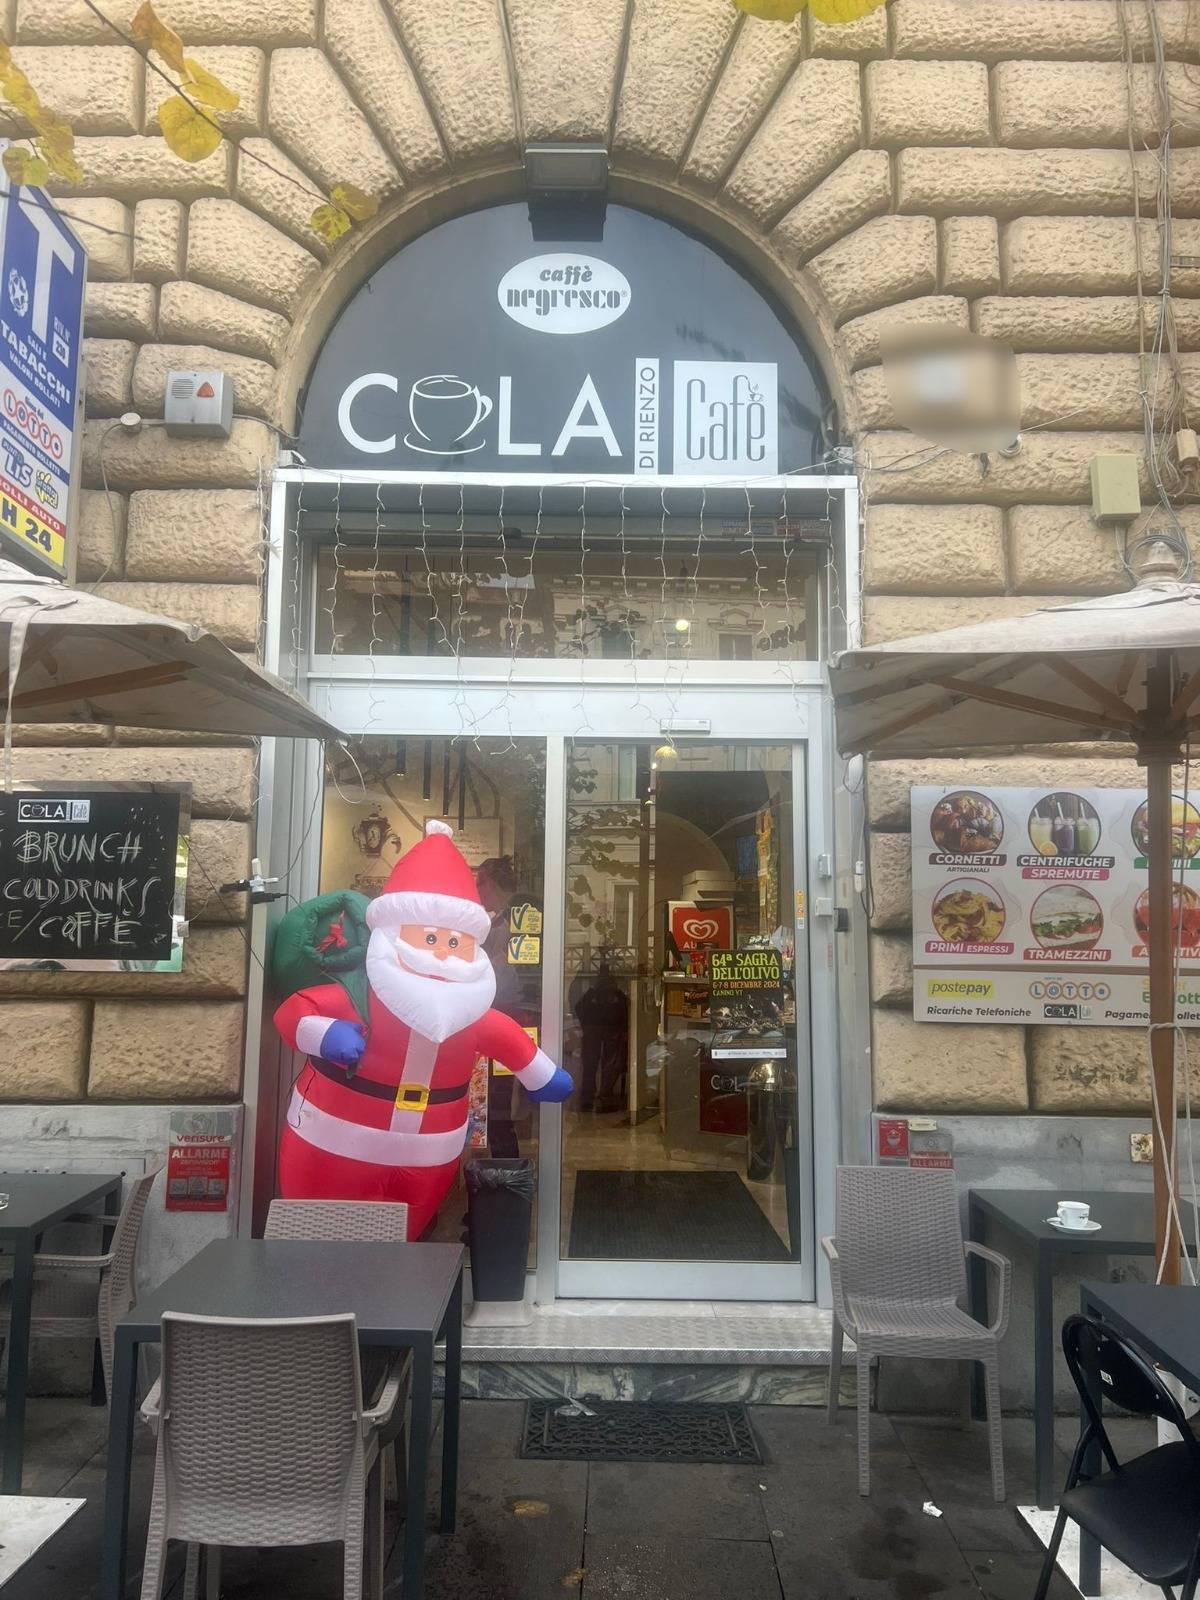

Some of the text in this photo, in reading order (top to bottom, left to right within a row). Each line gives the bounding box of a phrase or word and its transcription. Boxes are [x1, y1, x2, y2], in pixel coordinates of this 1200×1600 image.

[18, 185, 75, 344] T
[540, 265, 592, 286] caffè
[507, 289, 621, 316] negresco
[0, 320, 71, 404] TABACCHI
[338, 372, 622, 456] COLA
[638, 366, 656, 469] DI RIENZO
[0, 482, 28, 508] OLLI
[31, 503, 60, 531] AUTO
[2, 497, 52, 553] H 24
[20, 804, 65, 818] COLA
[13, 829, 143, 876] BRUNCH
[935, 854, 1000, 865] CORNETTI
[1020, 856, 1111, 868] CENTRIFUGHE
[1031, 868, 1101, 880] SPREMUTE
[930, 942, 1009, 954] PRIMI ESPRESSI
[1028, 949, 1108, 961] TRAMEZZINI
[736, 953, 779, 966] SAGRA
[712, 967, 780, 980] DELL'OLIVO
[730, 980, 762, 989] DICEMBRE
[931, 981, 991, 995] postepay
[1029, 981, 1111, 1001] LOTTO
[927, 1006, 1032, 1017] Ricariche Telefoniche
[171, 1149, 229, 1159] ALLARME
